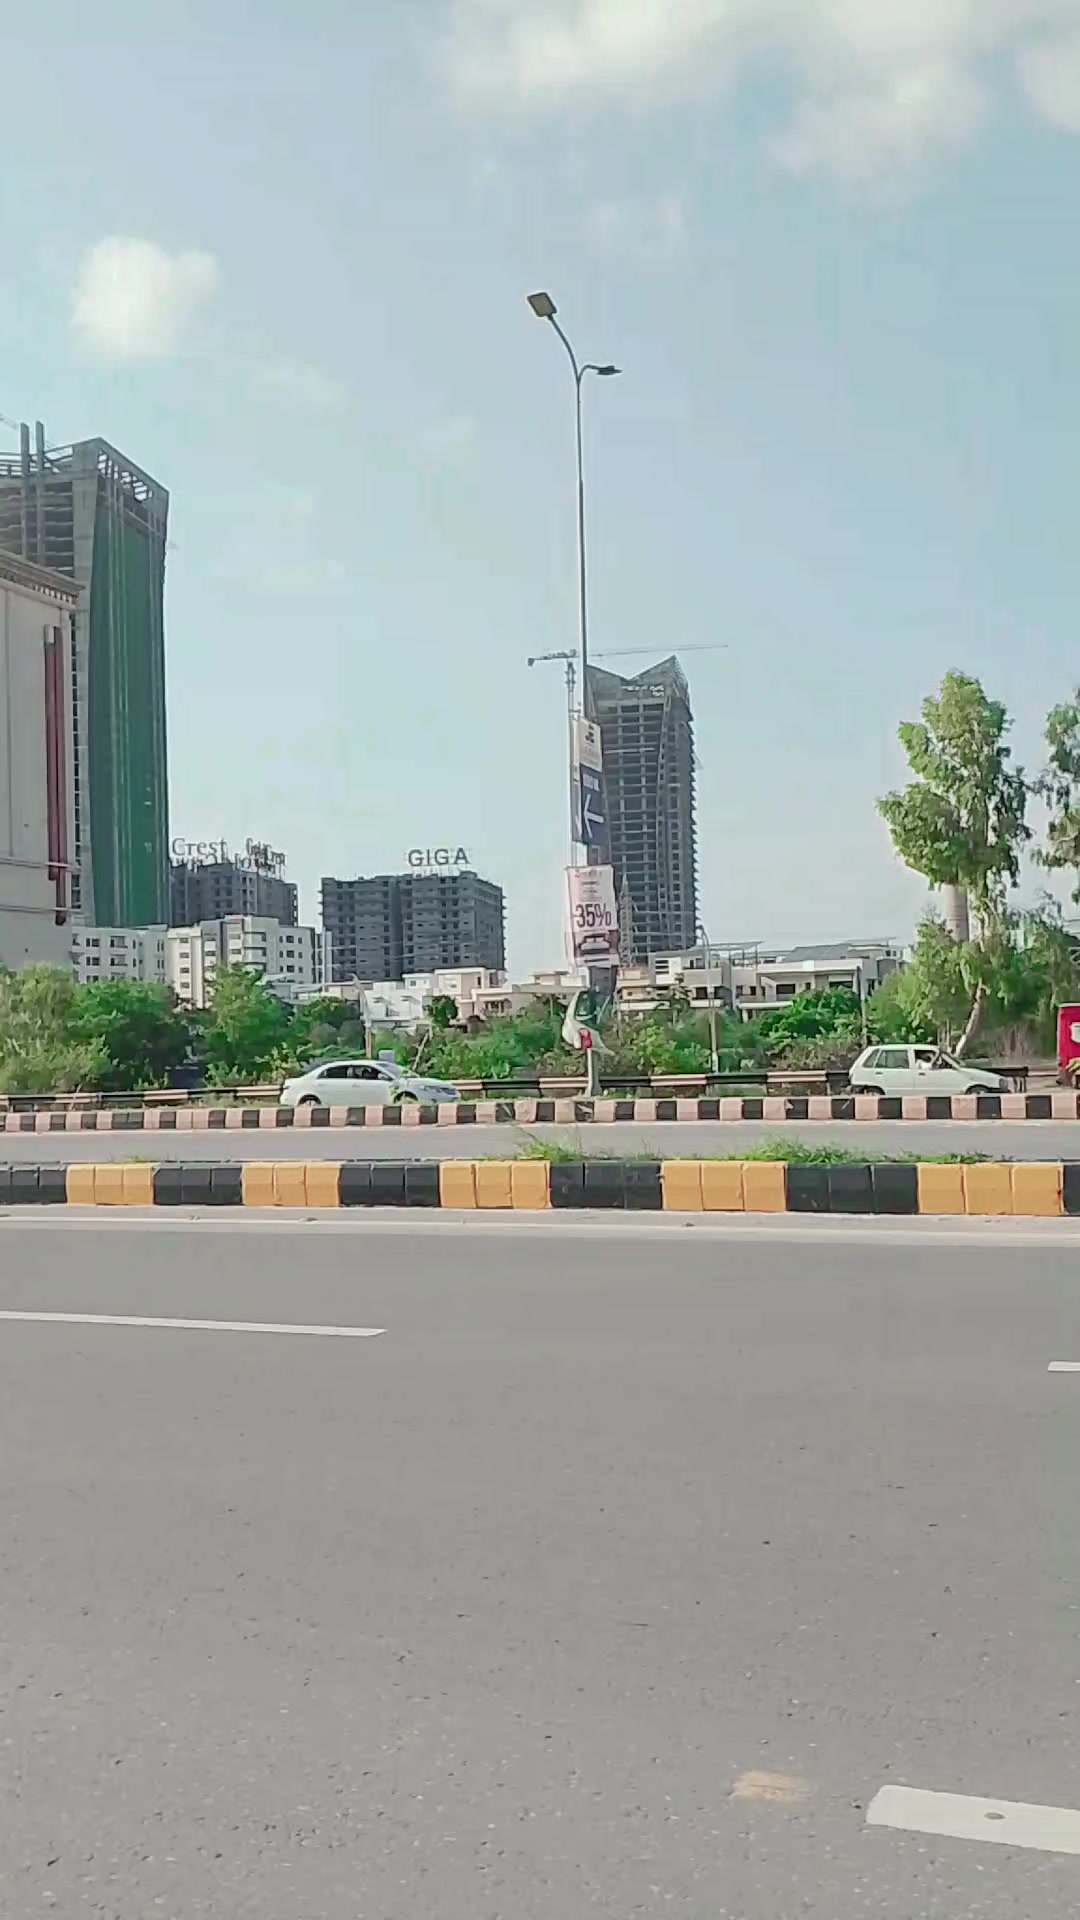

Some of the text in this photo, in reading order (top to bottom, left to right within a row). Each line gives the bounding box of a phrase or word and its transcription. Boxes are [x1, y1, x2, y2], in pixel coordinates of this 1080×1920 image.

[172, 838, 227, 857] Crest
[408, 847, 472, 866] GIGA
[576, 903, 612, 928] 35%
